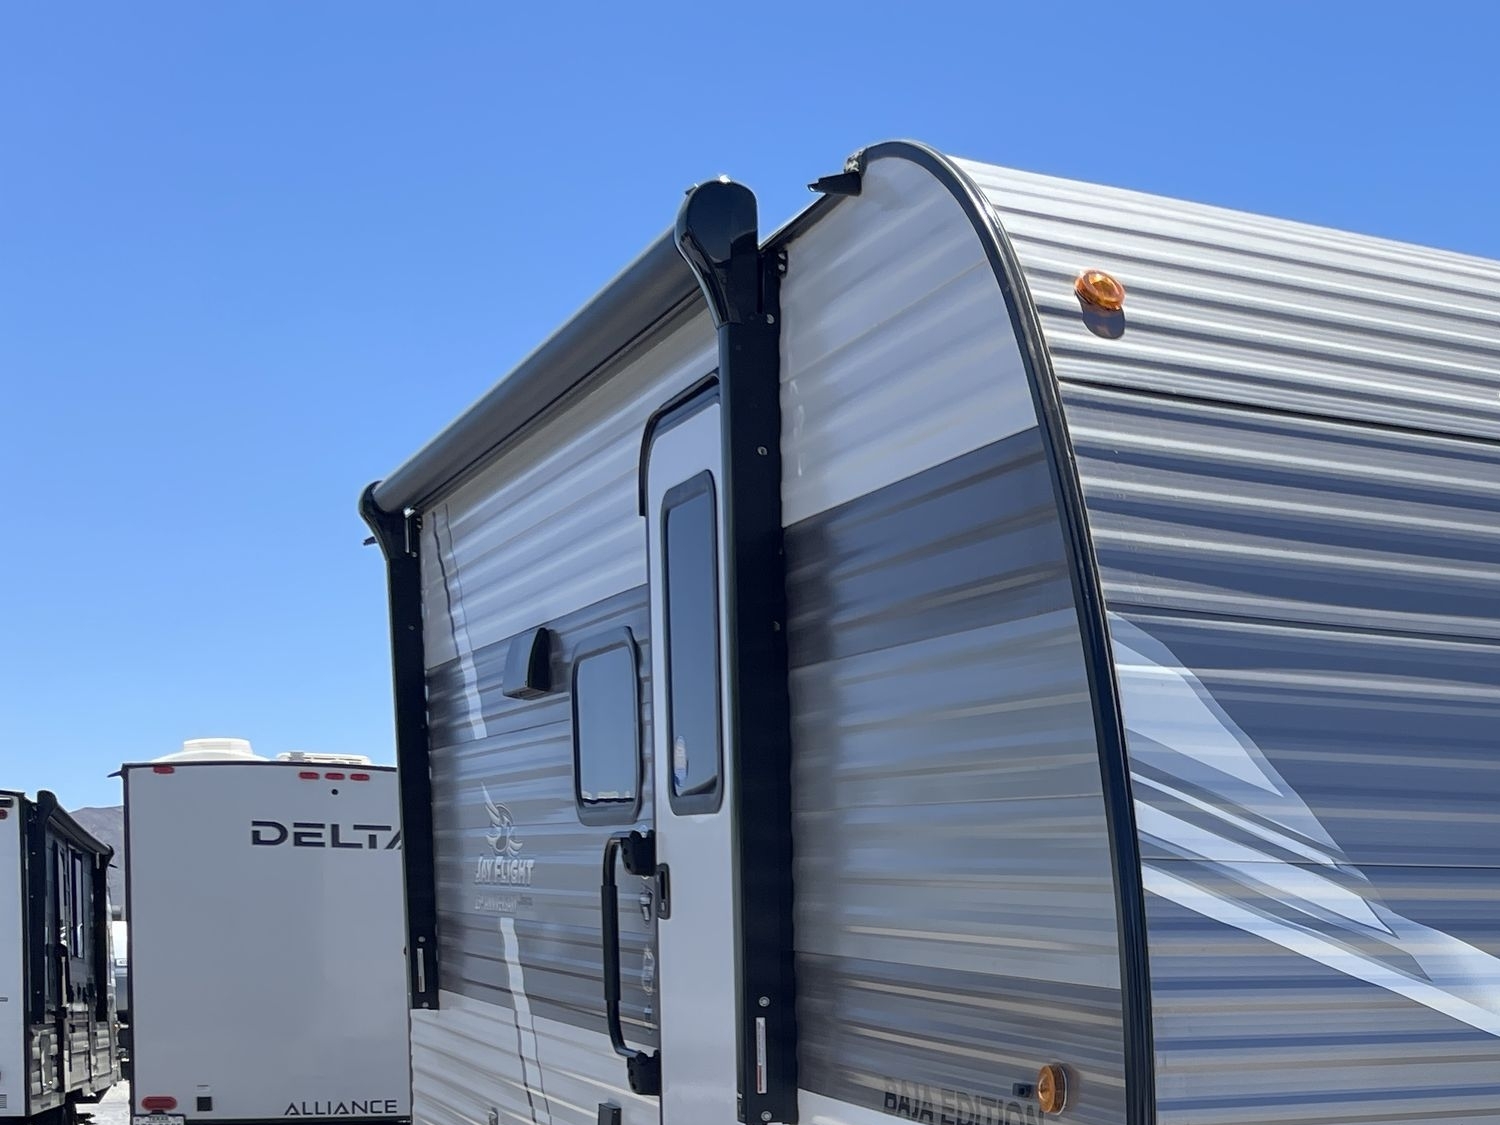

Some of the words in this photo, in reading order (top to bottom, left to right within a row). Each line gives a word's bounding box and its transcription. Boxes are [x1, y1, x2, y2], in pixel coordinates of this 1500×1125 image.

[475, 856, 495, 883] JAY
[495, 856, 535, 885] FLIGHT
[284, 1100, 397, 1115] ALLIANCE
[883, 1080, 935, 1123] BAJA
